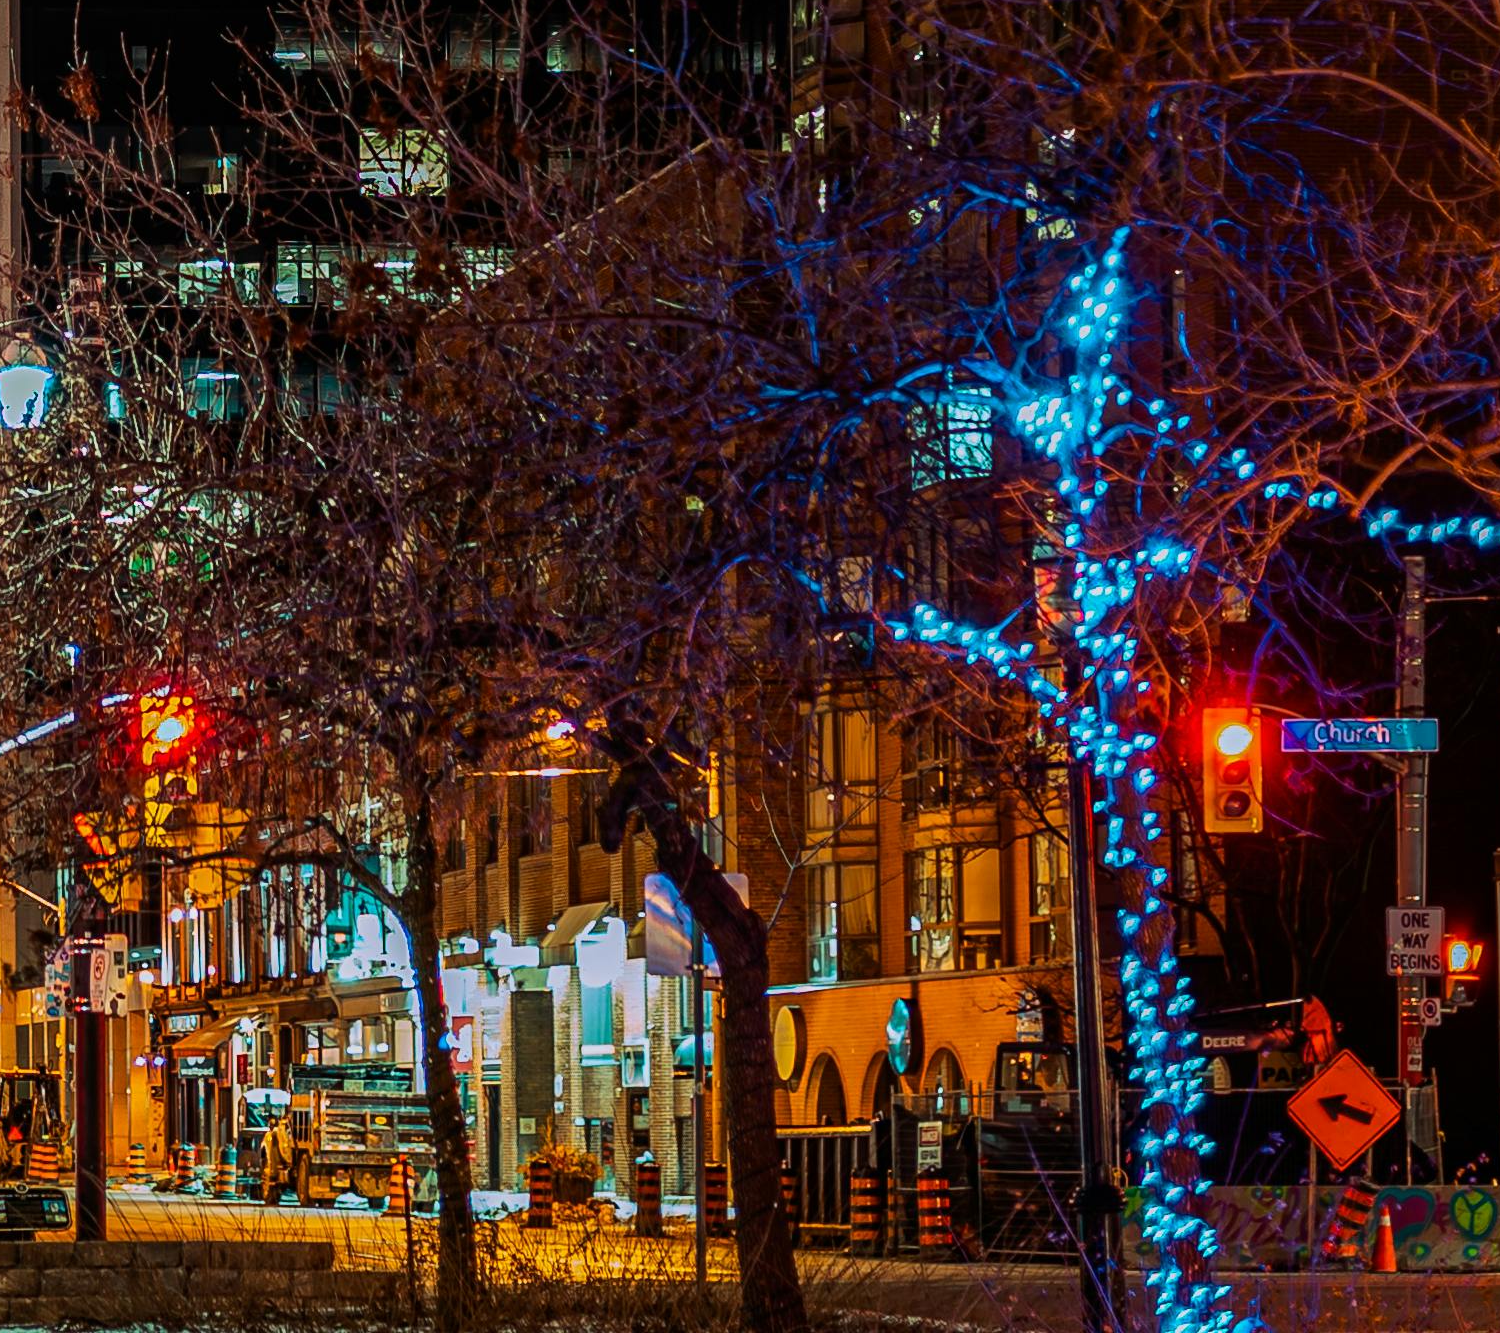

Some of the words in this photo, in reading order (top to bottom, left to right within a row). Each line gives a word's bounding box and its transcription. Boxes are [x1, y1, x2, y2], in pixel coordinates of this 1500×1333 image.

[1314, 722, 1391, 744] Church
[1395, 723, 1408, 735] St
[1401, 911, 1431, 929] ONE
[1401, 933, 1430, 950] WAY
[1390, 953, 1441, 971] BEGINS
[1202, 1034, 1246, 1049] DEERE
